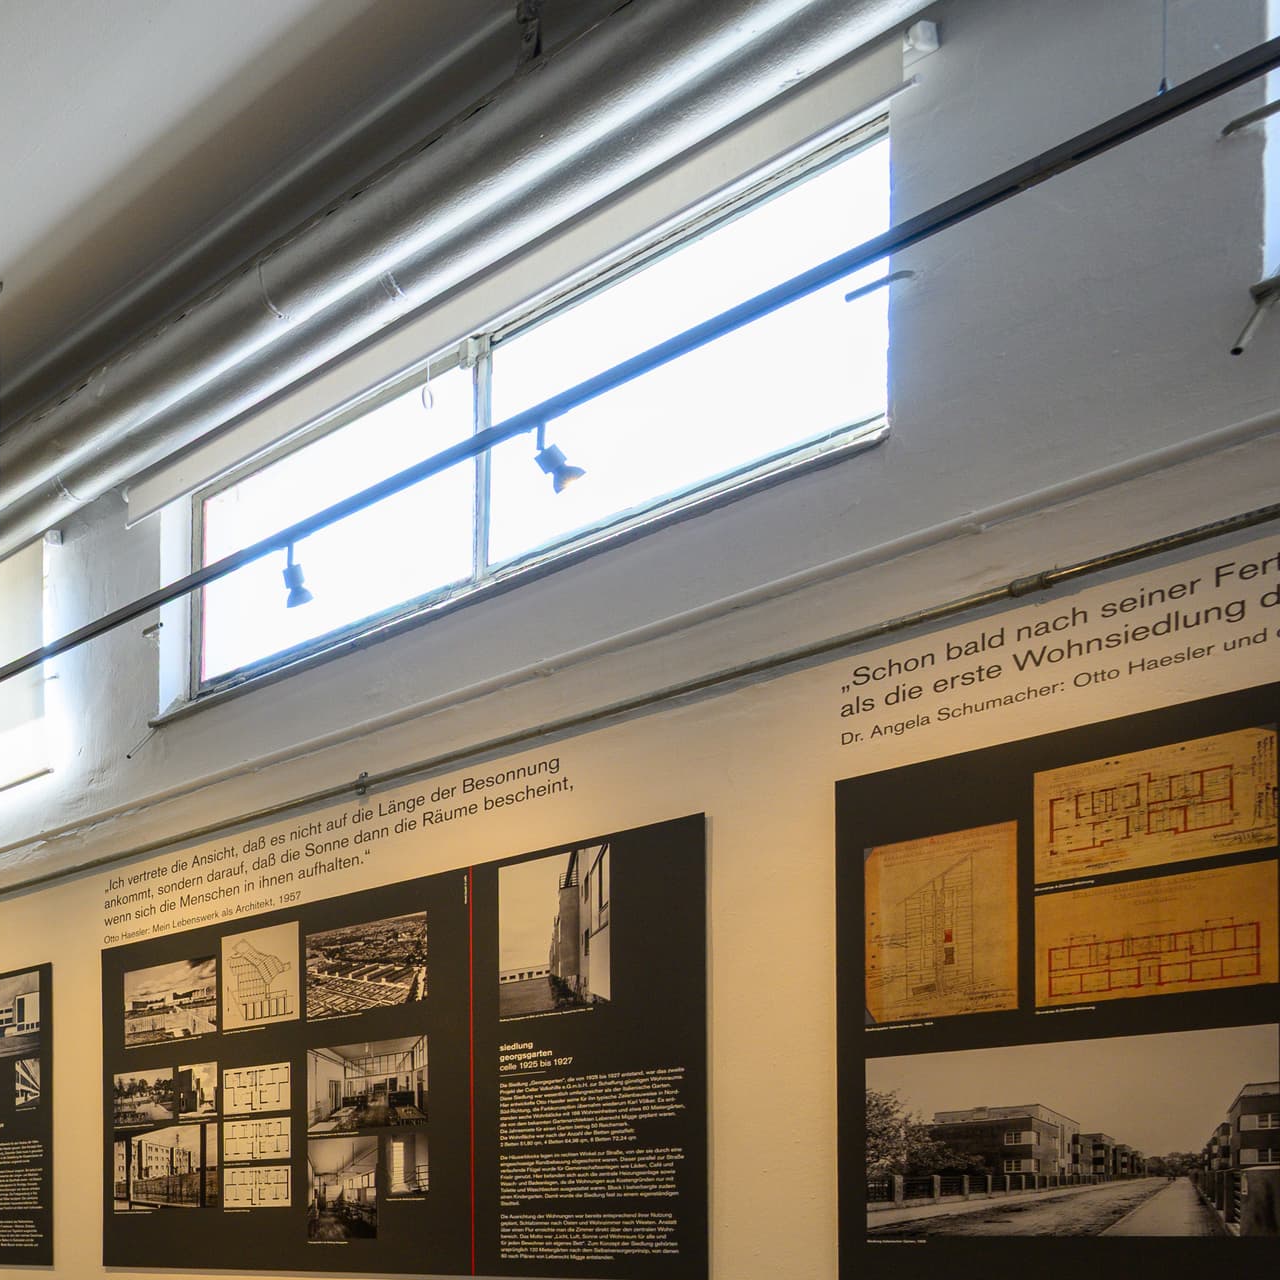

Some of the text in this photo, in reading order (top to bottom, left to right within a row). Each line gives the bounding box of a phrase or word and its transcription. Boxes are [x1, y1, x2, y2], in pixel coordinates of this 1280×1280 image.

[840, 692, 875, 717] als
[884, 682, 923, 708] die
[933, 663, 1003, 694] erste
[1013, 599, 1246, 672] Wohnsiedlung
[841, 651, 935, 694] „Schon
[945, 628, 1006, 660] bald
[1016, 607, 1088, 642] nach
[1101, 579, 1202, 618] seiner
[841, 628, 1267, 746] Dr. Angela Schumacher: Otto Haesler und
[104, 757, 560, 894] „Ich vertrete die Ansicht, daß es nicht auf die Länge der Besonnung
[104, 776, 574, 909] ankommt, sondern darauf, daß die Sonne dann die Räume bescheint,
[103, 890, 302, 945] Otto Haesler: Mein Lebenswerk als Architekt, 1957
[104, 849, 371, 927] wenn sich die Menschen in ihnen aufhalten.“
[499, 1041, 533, 1052] siedlung
[499, 1050, 553, 1063] georgsgarten
[499, 1057, 573, 1072] celle 1925 bis 1927
